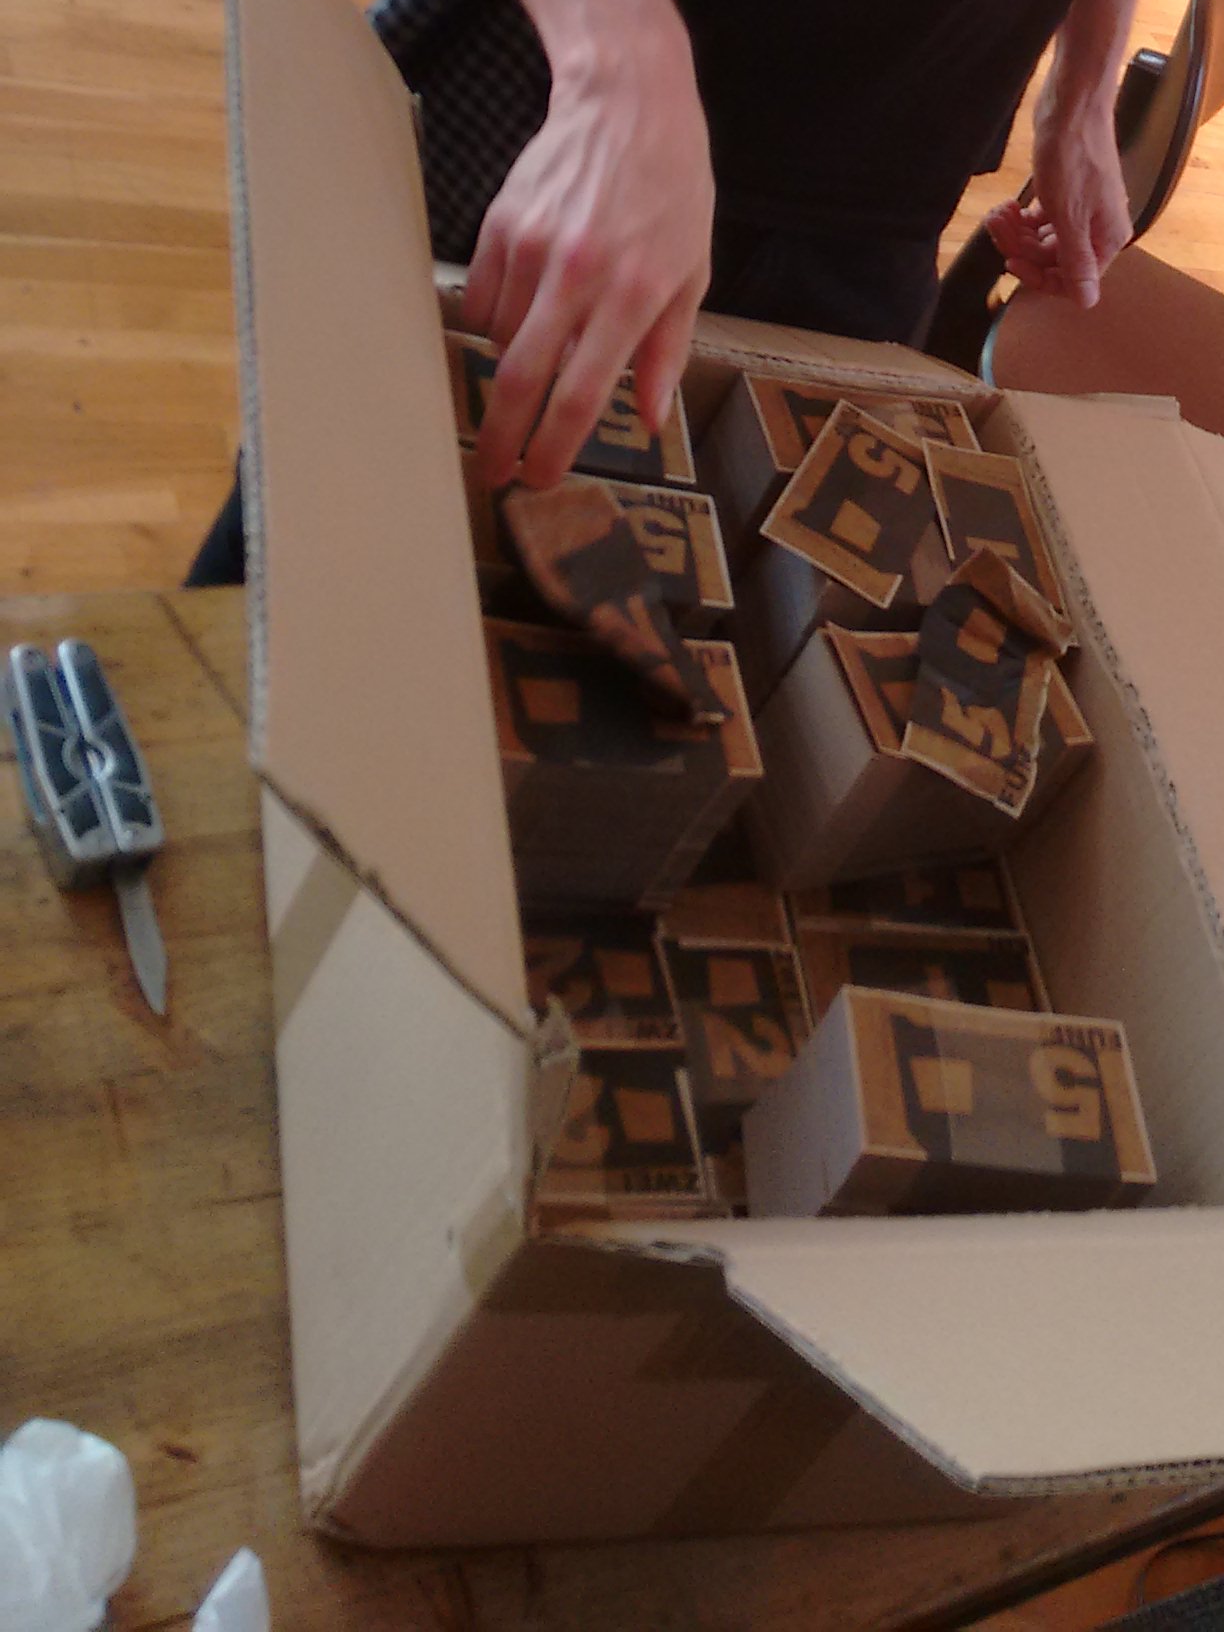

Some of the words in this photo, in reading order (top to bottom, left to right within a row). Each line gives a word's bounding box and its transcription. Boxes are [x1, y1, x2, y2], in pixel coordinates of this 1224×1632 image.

[847, 432, 922, 496] 5
[624, 506, 688, 575] 5
[940, 686, 1012, 759] 5
[1029, 1044, 1100, 1143] 5
